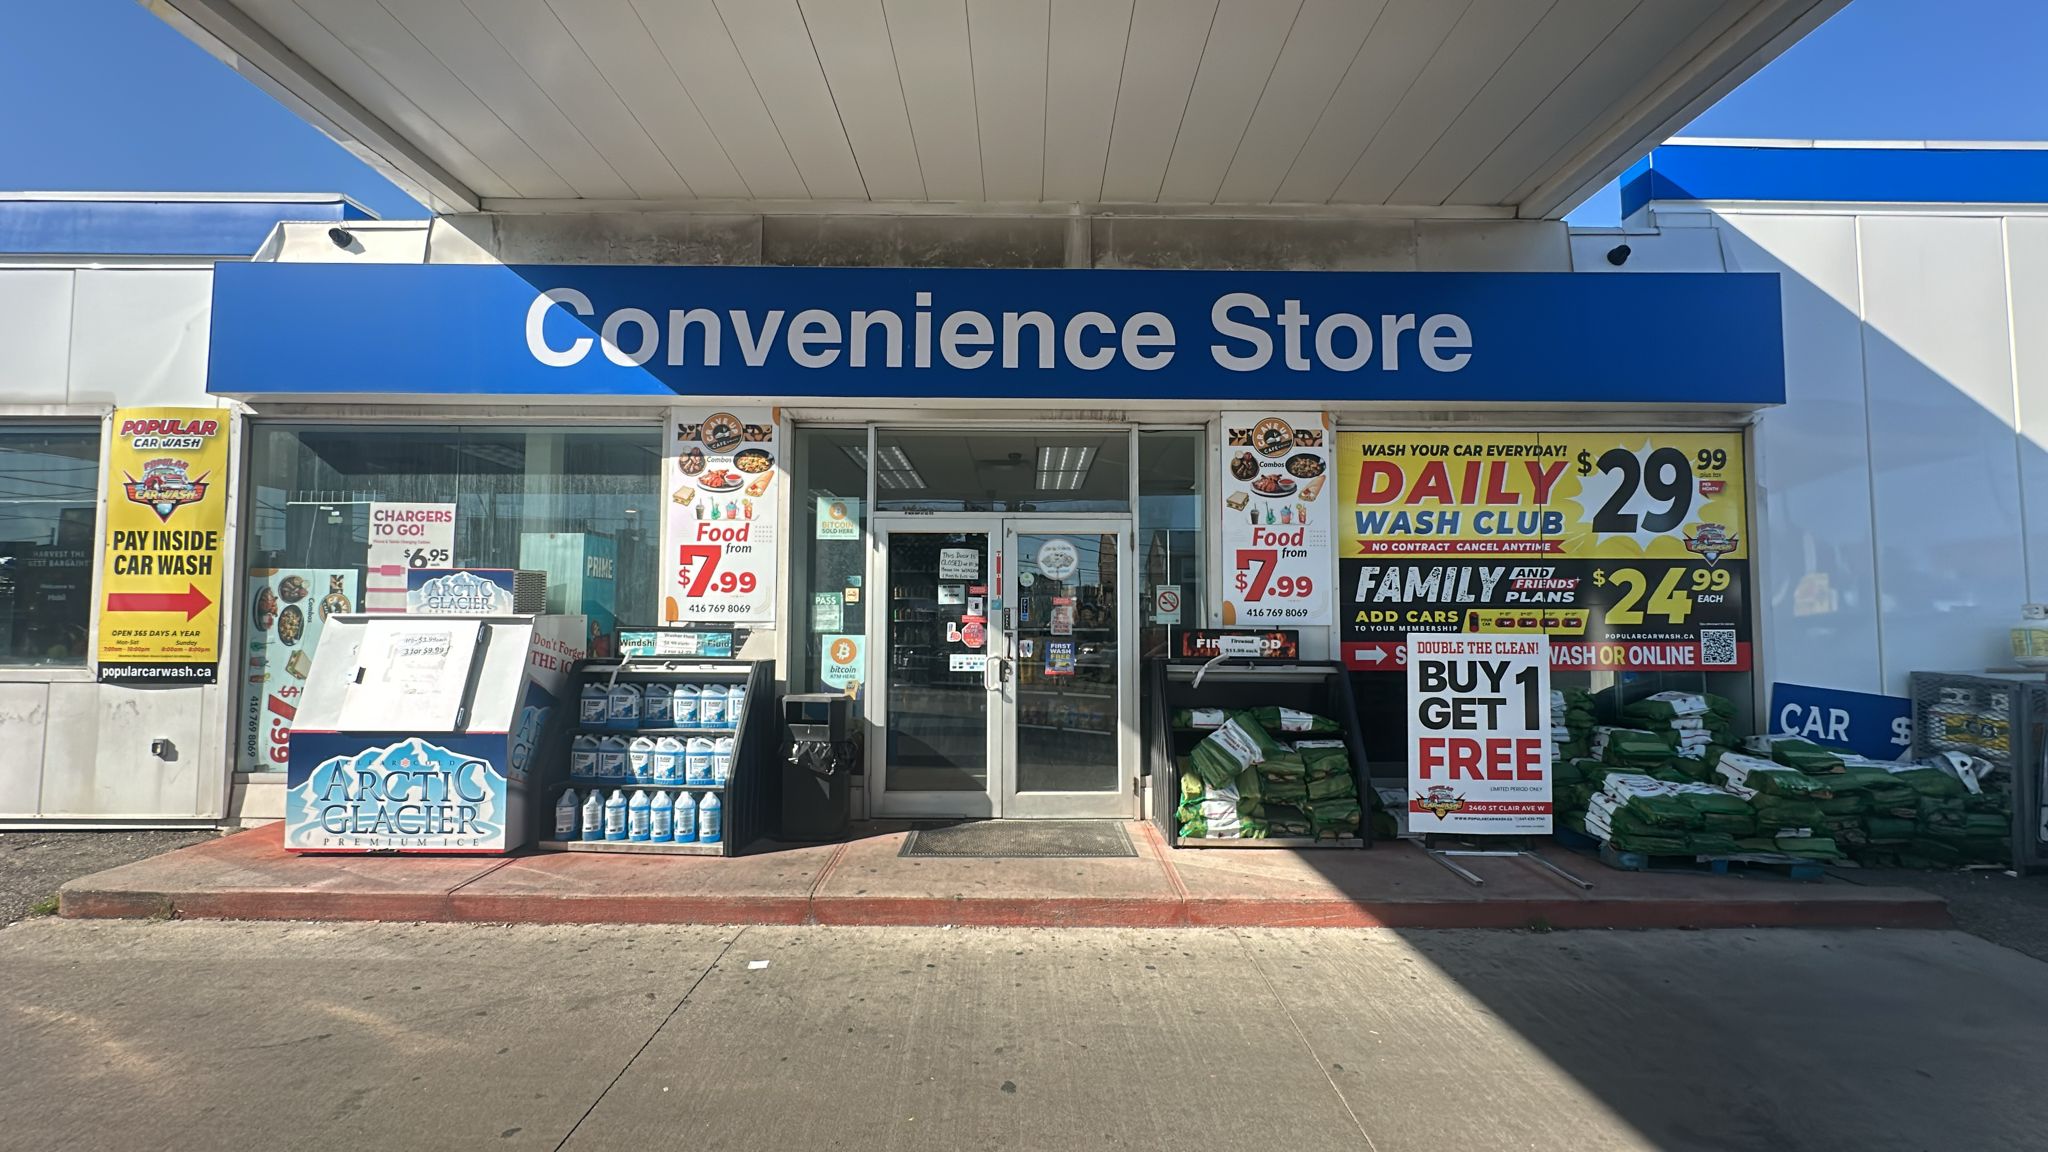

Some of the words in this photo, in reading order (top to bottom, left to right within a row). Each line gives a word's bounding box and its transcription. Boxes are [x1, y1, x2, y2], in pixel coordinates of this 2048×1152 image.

[526, 287, 1176, 371] Convenience
[1211, 292, 1473, 372] Store
[120, 419, 219, 436] POPULAR
[705, 418, 729, 442] CRAVE
[729, 422, 739, 434] UP
[1257, 423, 1279, 447] CRAVE
[1279, 427, 1289, 439] UP
[133, 438, 158, 448] CAR
[162, 438, 202, 448] WASH
[1362, 444, 1406, 456] WASH
[1410, 444, 1449, 456] YOUR
[1453, 444, 1483, 457] CAR
[1486, 445, 1567, 457] EVERYDAY!
[1697, 448, 1727, 471] 99
[1356, 460, 1570, 506] DAILY
[374, 510, 452, 522] CHARGERS
[1355, 511, 1461, 535] WASH
[1473, 511, 1565, 535] CLUB
[373, 524, 394, 535] TO
[397, 524, 424, 536] GO!
[696, 523, 750, 542] Food
[1252, 527, 1304, 546] Food
[113, 531, 149, 550] PAY
[153, 531, 217, 550] INSIDE
[726, 543, 752, 554] from
[1372, 543, 1390, 551] NO
[1391, 543, 1450, 551] CONTRACT
[1456, 543, 1499, 551] CANCEL
[1502, 543, 1551, 551] ANYTIME
[404, 548, 449, 568] $6.95
[1282, 547, 1307, 558] from
[114, 555, 153, 575] CAR
[158, 555, 212, 575] WASH
[587, 555, 613, 579] PRIME
[678, 545, 757, 598] $7.99
[1235, 549, 1313, 602] $7.99
[1355, 566, 1506, 603] FAMILY
[1515, 568, 1550, 578] AND
[1515, 579, 1575, 589] FRIENDS
[1690, 568, 1731, 592] 99
[428, 580, 493, 597] ARCTIC
[1505, 591, 1575, 603] PLANS
[428, 597, 492, 610] GLACIER
[815, 597, 836, 605] PASS
[1697, 594, 1723, 603] EACH
[307, 597, 315, 623] Combos
[689, 604, 706, 613] 416
[708, 604, 725, 613] 769
[727, 604, 751, 613] 8069
[1246, 609, 1264, 617] 416
[1266, 609, 1283, 617] 769
[1285, 609, 1308, 617] 8069
[1355, 610, 1399, 623] ADD
[1405, 610, 1459, 623] CARS
[533, 632, 556, 648] Don't
[560, 640, 584, 660] Forget
[1197, 638, 1281, 649] FIROD
[1417, 642, 1464, 654] DOUBLE
[1469, 642, 1493, 654] THE
[1495, 642, 1539, 654] CLEAN!
[531, 650, 557, 671] THE
[560, 660, 573, 673] IC
[1600, 646, 1625, 665] OR
[1629, 646, 1695, 665] ONLINE
[102, 666, 211, 678] popularcarwash.ca
[1419, 661, 1511, 693] BUY
[1515, 666, 1540, 730] 1
[250, 696, 258, 716] 416
[1419, 697, 1507, 730] GET
[249, 718, 257, 735] 769
[1780, 702, 1850, 742] CAR
[247, 736, 257, 758] 8069
[1419, 738, 1543, 780] FREE
[320, 760, 487, 802] ARCTIC
[320, 805, 485, 835] GLACIER
[323, 838, 427, 847] PREMIUM
[444, 838, 480, 847] ICE
